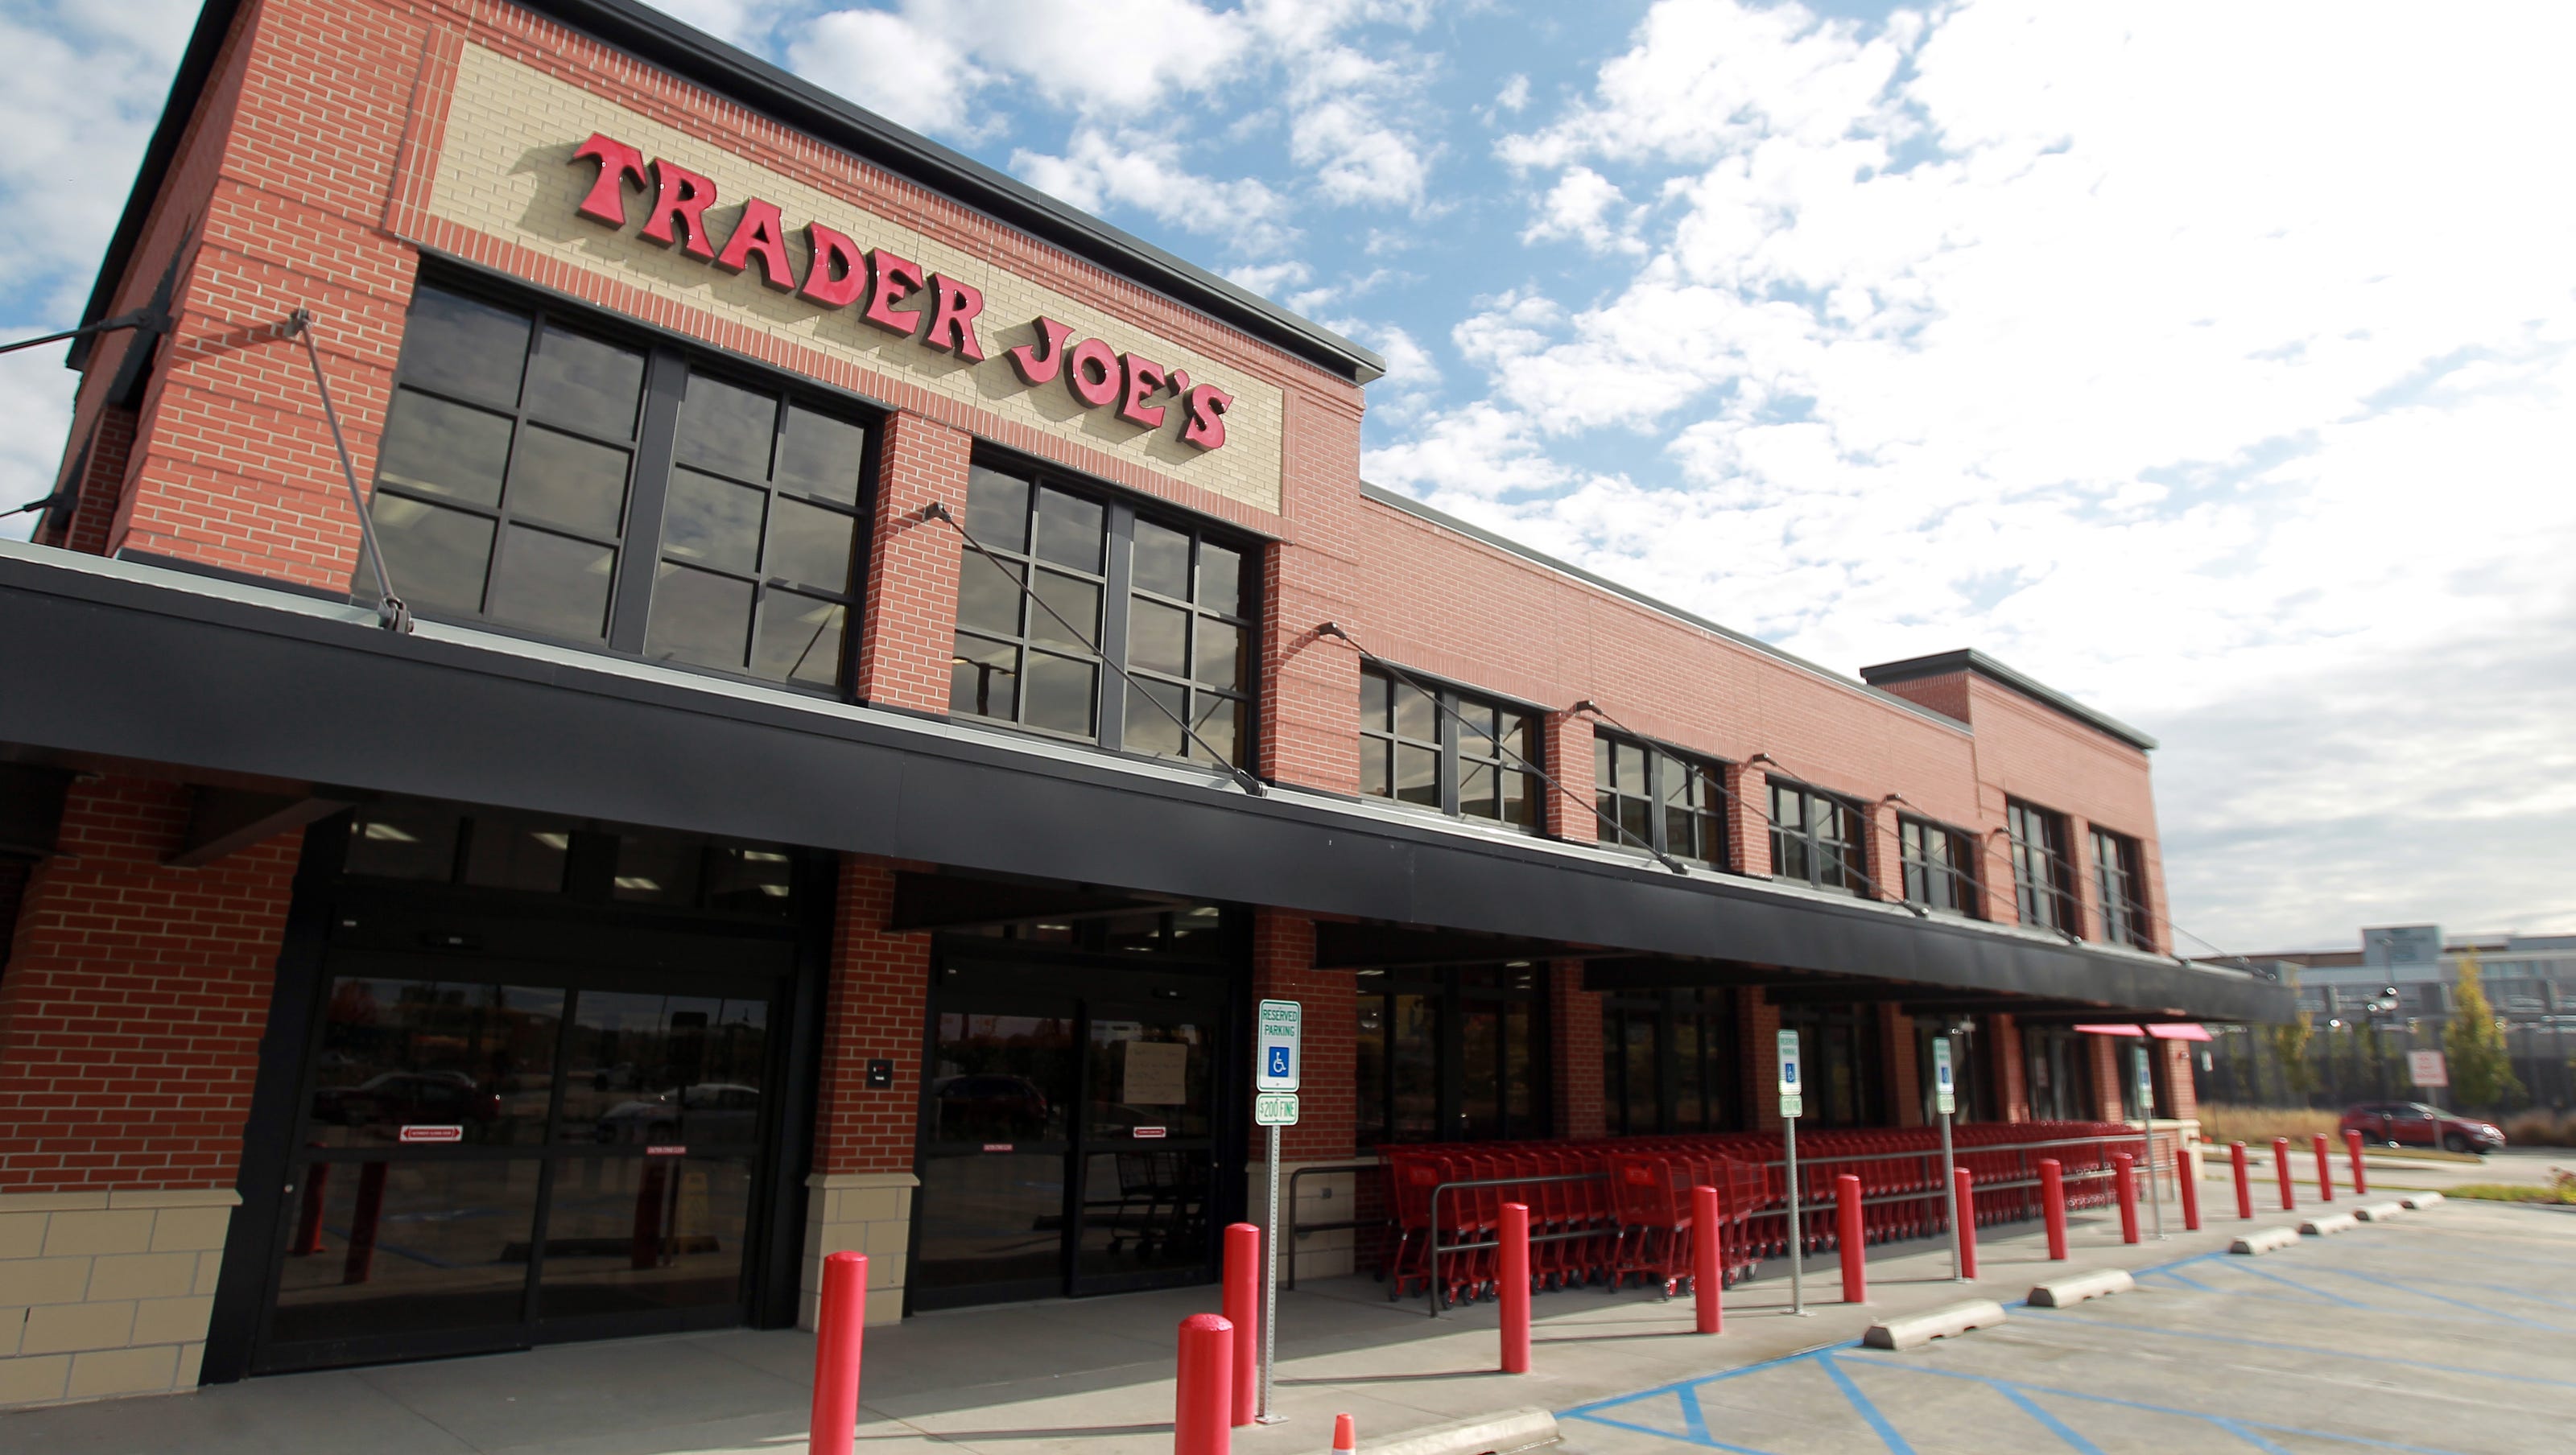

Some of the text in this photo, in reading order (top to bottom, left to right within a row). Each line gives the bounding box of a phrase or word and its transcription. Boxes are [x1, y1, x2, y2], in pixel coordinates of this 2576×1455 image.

[571, 131, 1235, 452] TRADER JOE'S
[1262, 1009, 1298, 1022] RESERVED
[1265, 1024, 1294, 1037] PARKING
[1260, 1100, 1294, 1118] $200 FINE
